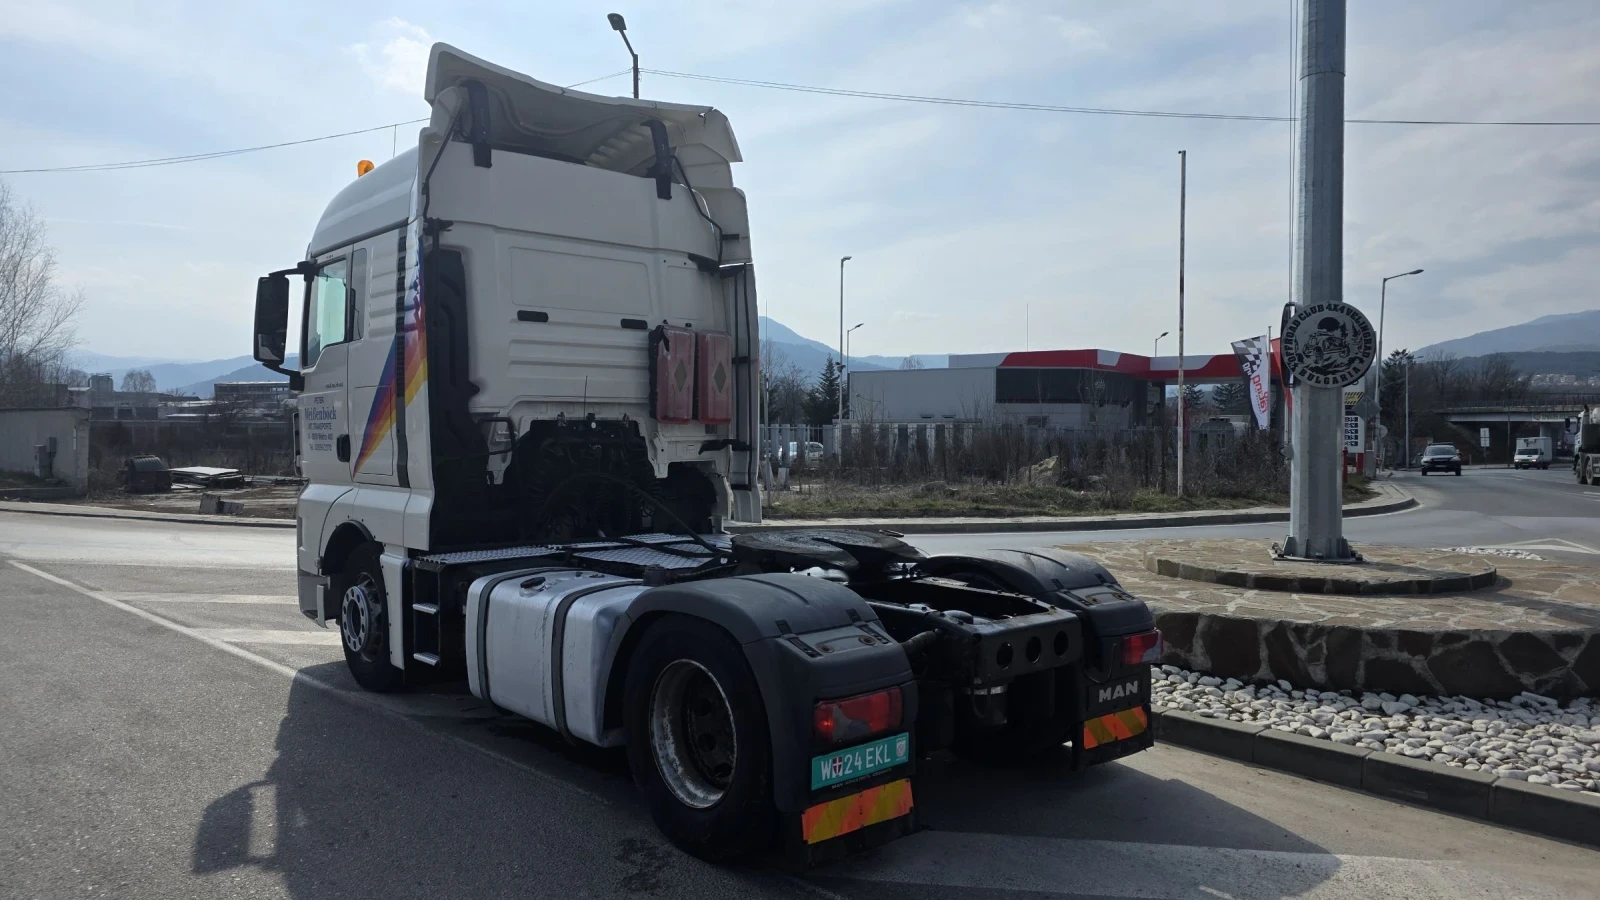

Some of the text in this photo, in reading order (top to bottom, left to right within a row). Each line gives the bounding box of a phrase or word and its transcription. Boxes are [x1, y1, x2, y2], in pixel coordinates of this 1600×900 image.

[1284, 319, 1301, 363] OFFROAD
[1298, 303, 1325, 322] CLUB
[1345, 306, 1373, 359] VELINGRAD
[1298, 366, 1361, 385] BULGARIA
[1098, 680, 1138, 703] MAN
